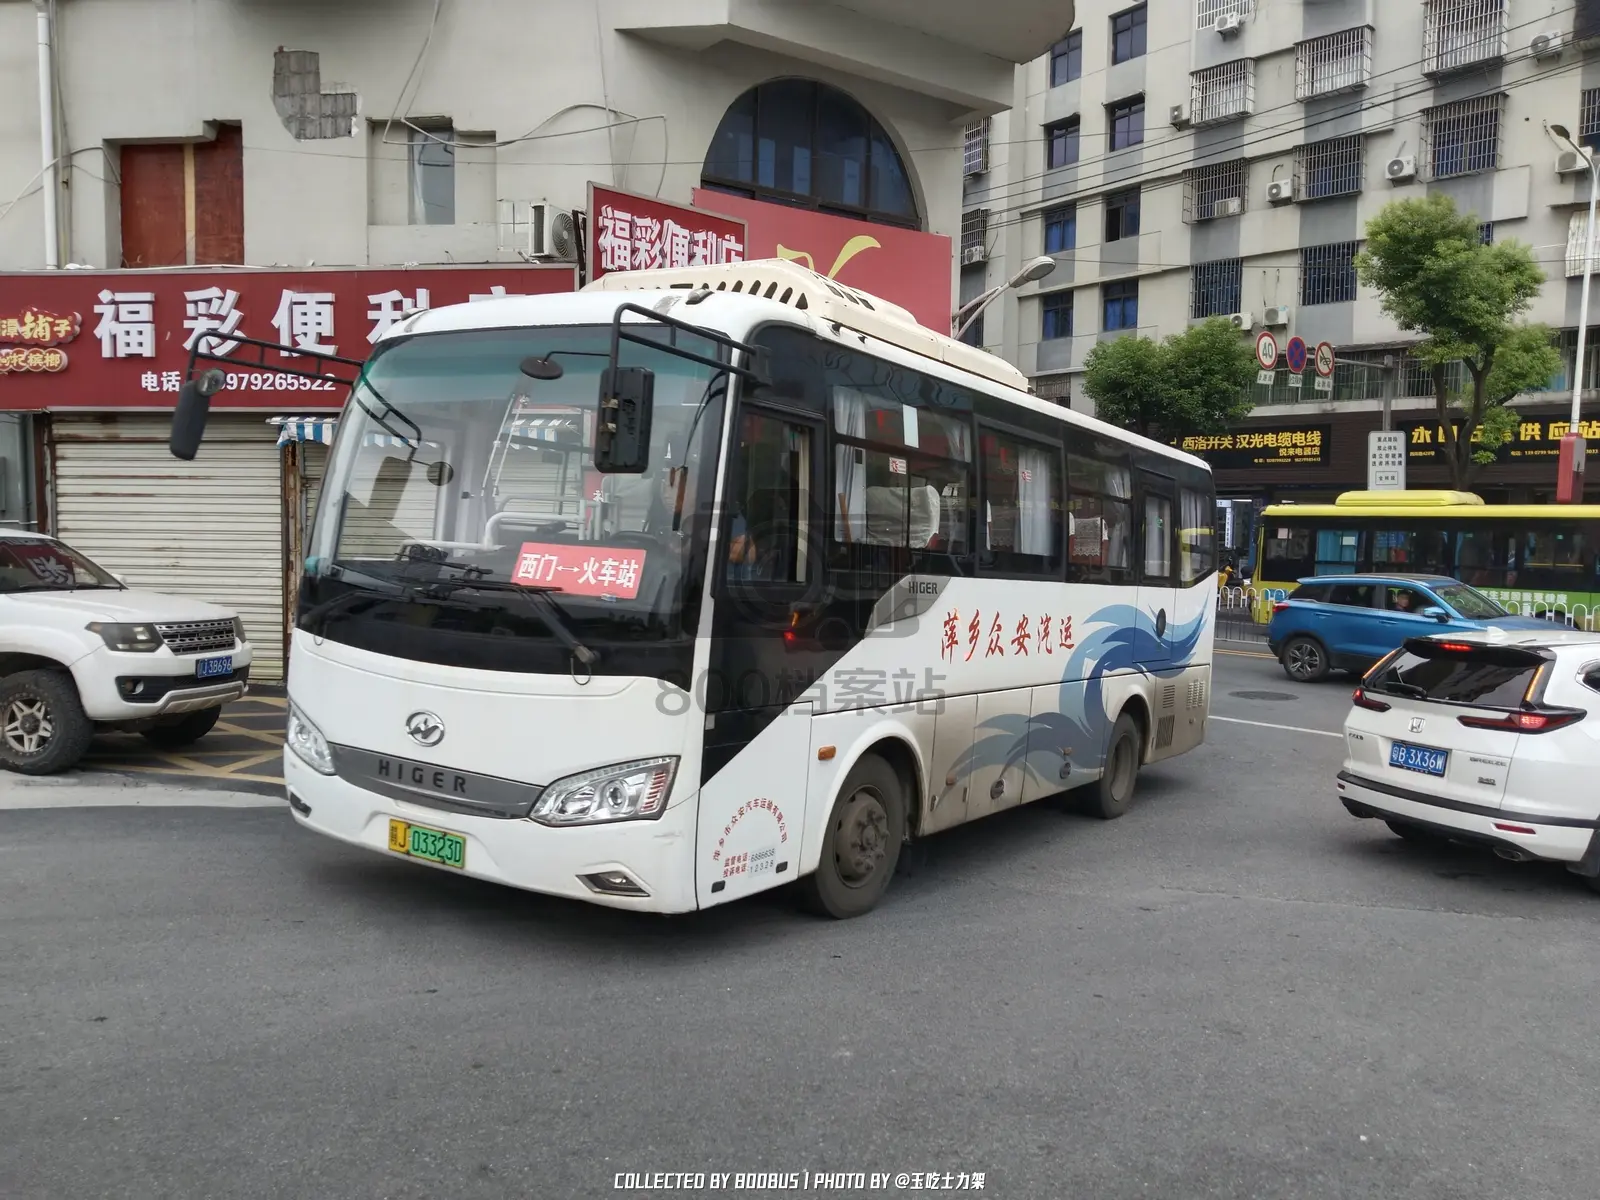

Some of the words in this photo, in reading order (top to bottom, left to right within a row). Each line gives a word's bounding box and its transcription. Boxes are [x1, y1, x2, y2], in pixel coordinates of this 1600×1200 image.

[93, 286, 526, 358] 福彩便利
[1262, 343, 1274, 359] 40
[141, 371, 181, 392] 电话
[1236, 431, 1321, 449] 汉光电缆电线
[577, 557, 638, 588] 火车站
[908, 581, 938, 595] HIGER
[941, 608, 1075, 664] 萍乡众安汽运
[378, 759, 466, 793] HIGER
